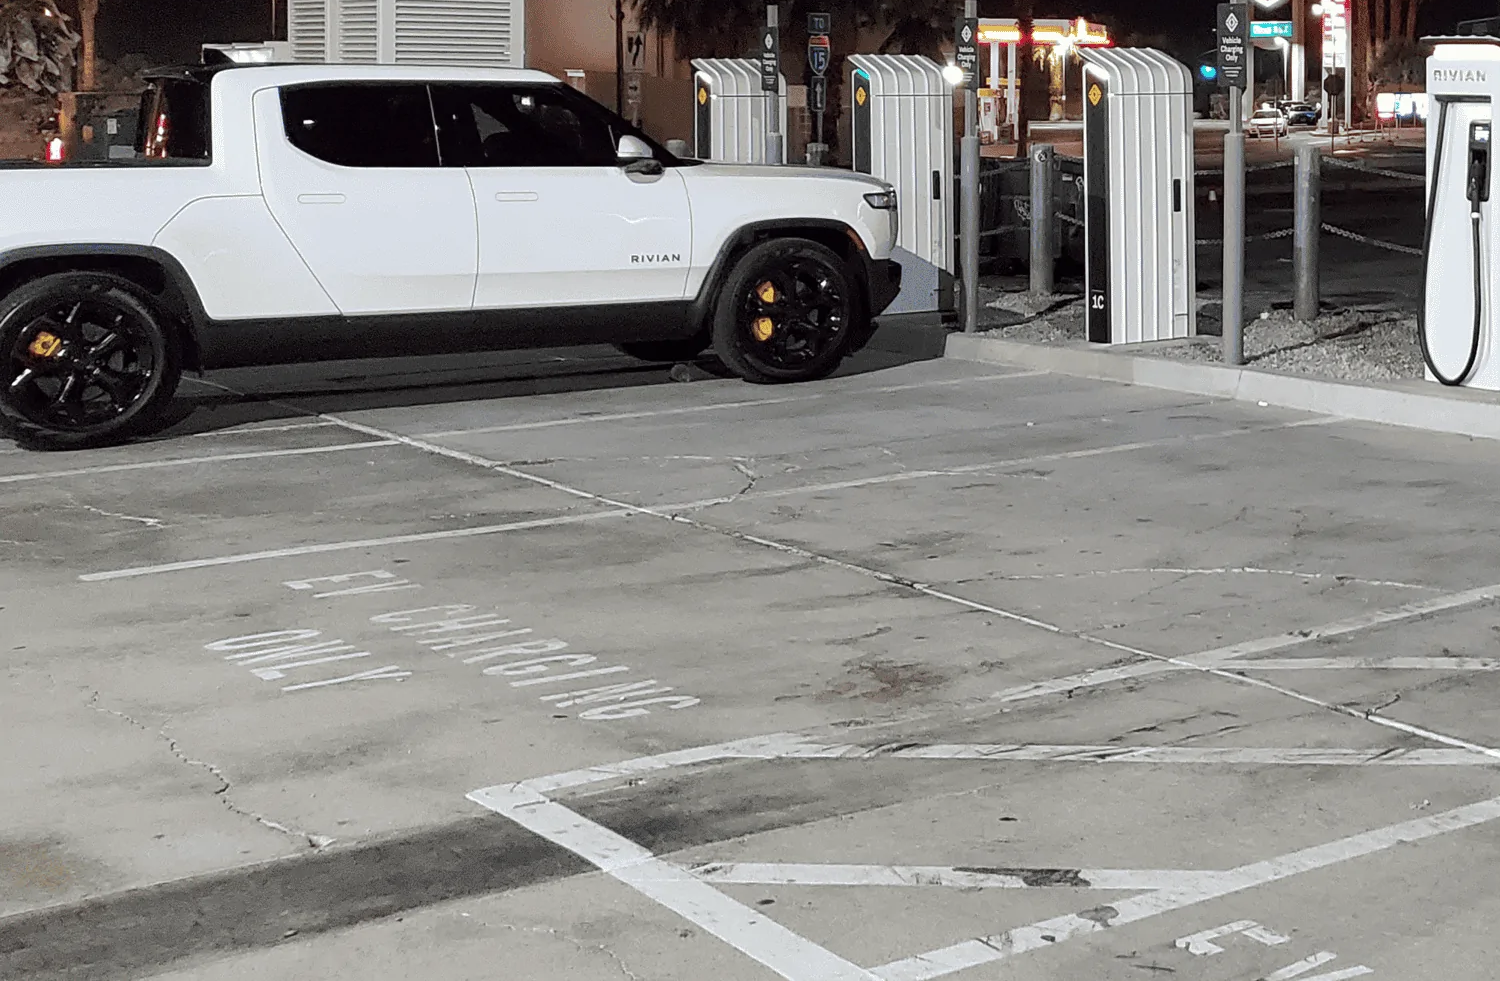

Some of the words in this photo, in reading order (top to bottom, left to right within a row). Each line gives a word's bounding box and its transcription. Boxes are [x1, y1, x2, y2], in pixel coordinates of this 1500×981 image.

[813, 17, 825, 29] TO
[1222, 36, 1241, 44] Vehicle
[813, 51, 826, 70] 15
[1433, 69, 1486, 82] RIVIAN
[630, 253, 681, 263] RIVIAN
[1091, 294, 1105, 310] 1C
[283, 569, 424, 599] EV
[369, 603, 701, 720] CHARGING
[203, 628, 413, 693] ONLY
